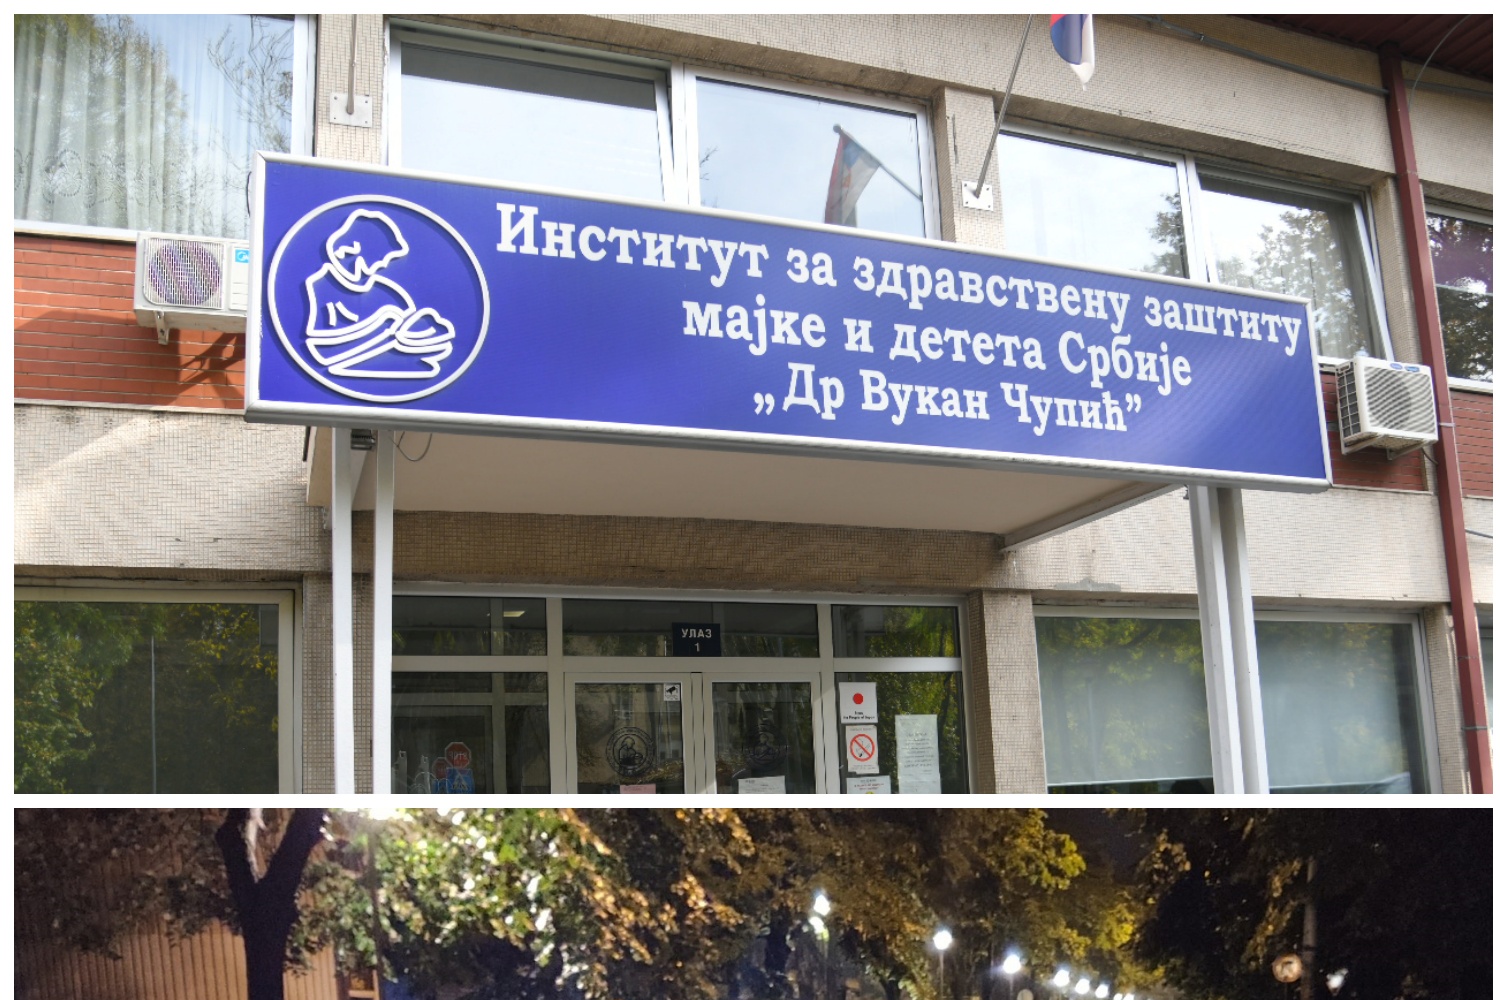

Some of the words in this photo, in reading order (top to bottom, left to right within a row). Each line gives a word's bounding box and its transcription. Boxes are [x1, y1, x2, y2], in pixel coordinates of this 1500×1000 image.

[496, 202, 770, 288] Институт
[786, 247, 838, 287] за
[852, 255, 1131, 334] здравствену
[1143, 295, 1302, 357] заштиту
[682, 293, 827, 356] мајке
[842, 317, 874, 354] и
[889, 323, 1047, 371] детета
[1058, 330, 1193, 397] Србије
[859, 368, 990, 426] Вукан
[681, 628, 712, 638] УЛАЗ
[694, 642, 700, 652] 1
